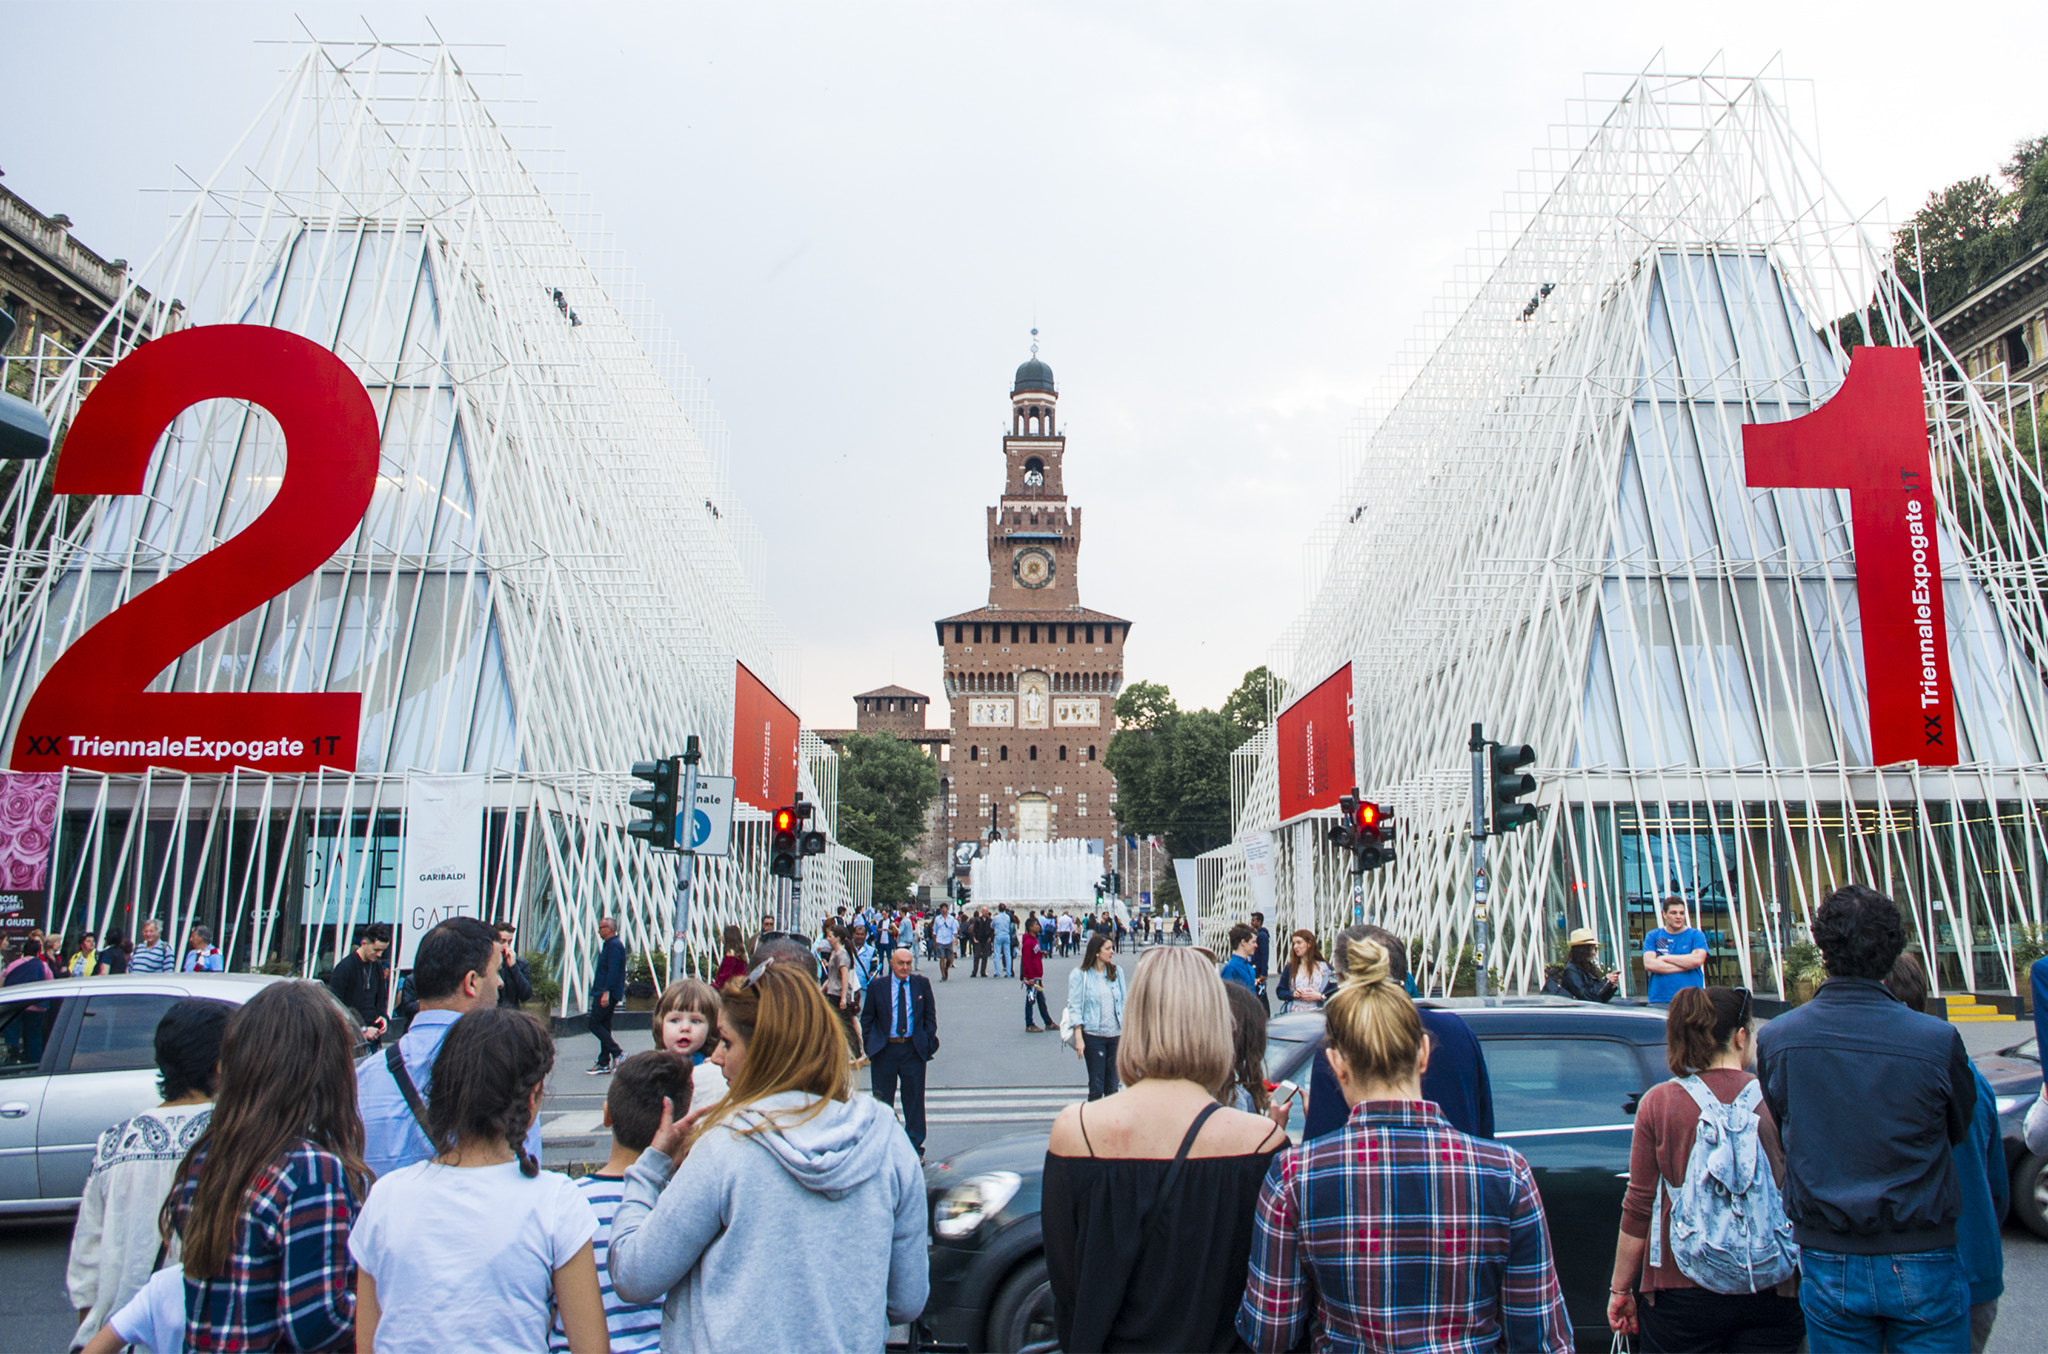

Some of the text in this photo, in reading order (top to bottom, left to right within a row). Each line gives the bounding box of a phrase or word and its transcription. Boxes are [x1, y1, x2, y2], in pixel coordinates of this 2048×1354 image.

[10, 324, 380, 772] 2
[1742, 346, 1958, 766] 1
[1901, 467, 1944, 747] XX TriennaleExpogate 1T
[26, 736, 341, 760] XX TriennaleExpogate 1T
[677, 794, 721, 804] enale
[419, 873, 466, 881] GARIBALDI
